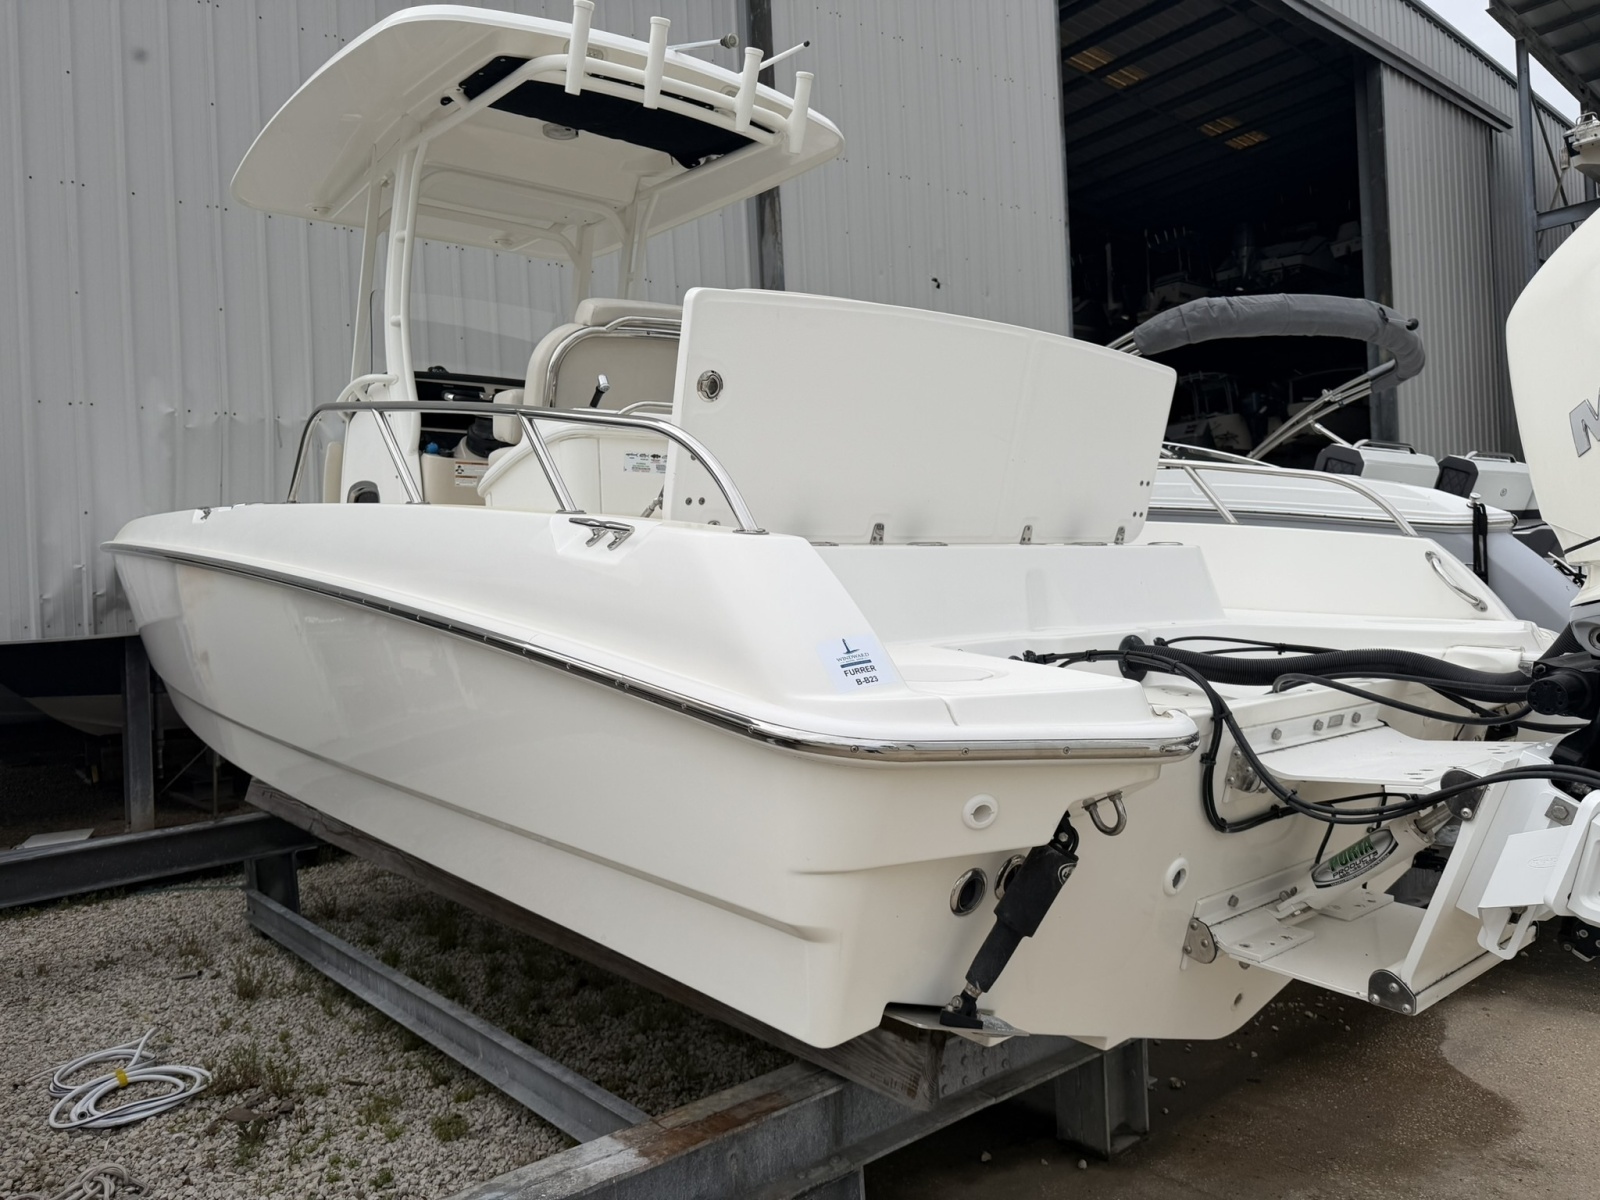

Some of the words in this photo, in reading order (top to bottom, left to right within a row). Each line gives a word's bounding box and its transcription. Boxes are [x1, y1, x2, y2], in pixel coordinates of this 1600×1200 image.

[843, 665, 877, 677] FURRER
[855, 675, 879, 685] B-B23
[1332, 850, 1379, 878] PRODUCTS
